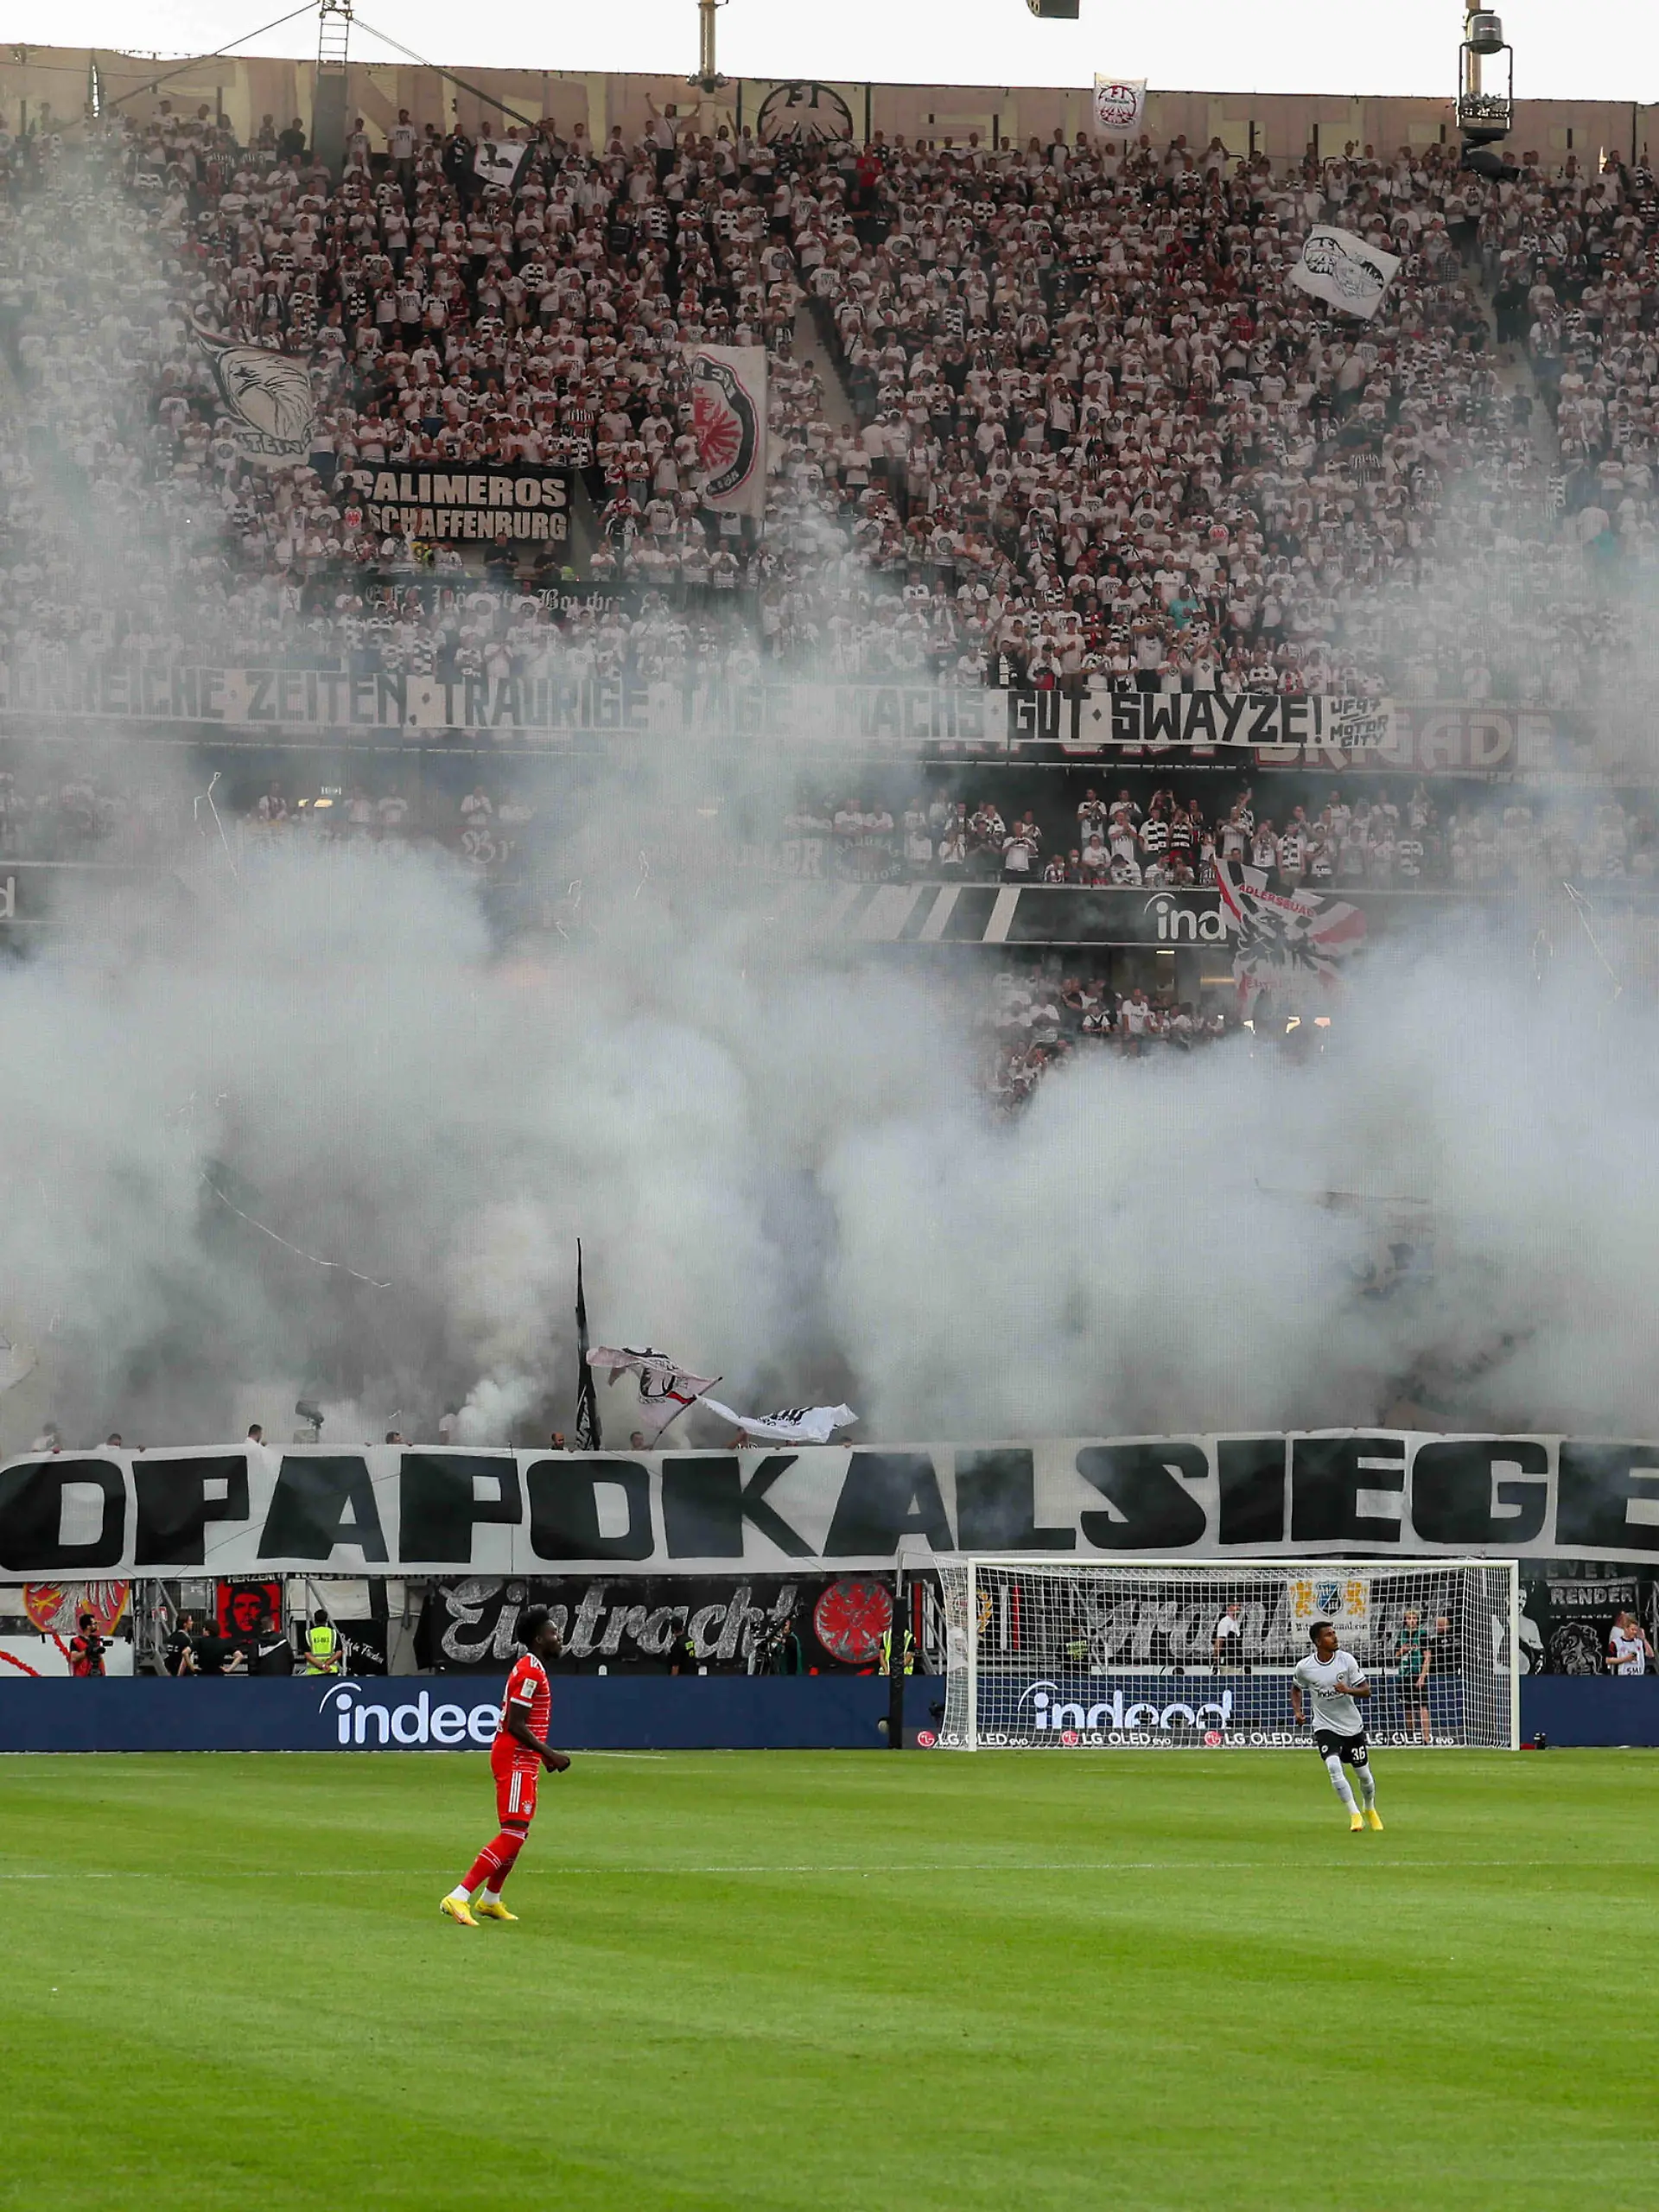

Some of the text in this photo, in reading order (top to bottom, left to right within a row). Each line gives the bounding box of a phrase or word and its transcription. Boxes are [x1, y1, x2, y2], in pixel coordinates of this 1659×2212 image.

[368, 504, 567, 540] SCHAFFENBURG
[1330, 696, 1381, 715] UF97
[1009, 691, 1090, 739] GUT
[1111, 691, 1322, 744] SWAYZE!
[1330, 718, 1388, 741] MOTOR
[1341, 734, 1382, 747] CITY
[1155, 900, 1227, 939] ind
[1524, 1560, 1618, 1579] EVER
[337, 1690, 500, 1745] indee
[1033, 1689, 1233, 1729] indeed
[1082, 1733, 1104, 1745] LG
[1108, 1732, 1150, 1745] OLED
[1224, 1733, 1245, 1745] LG
[1251, 1732, 1293, 1745] OLED
[1351, 1745, 1366, 1761] 36
